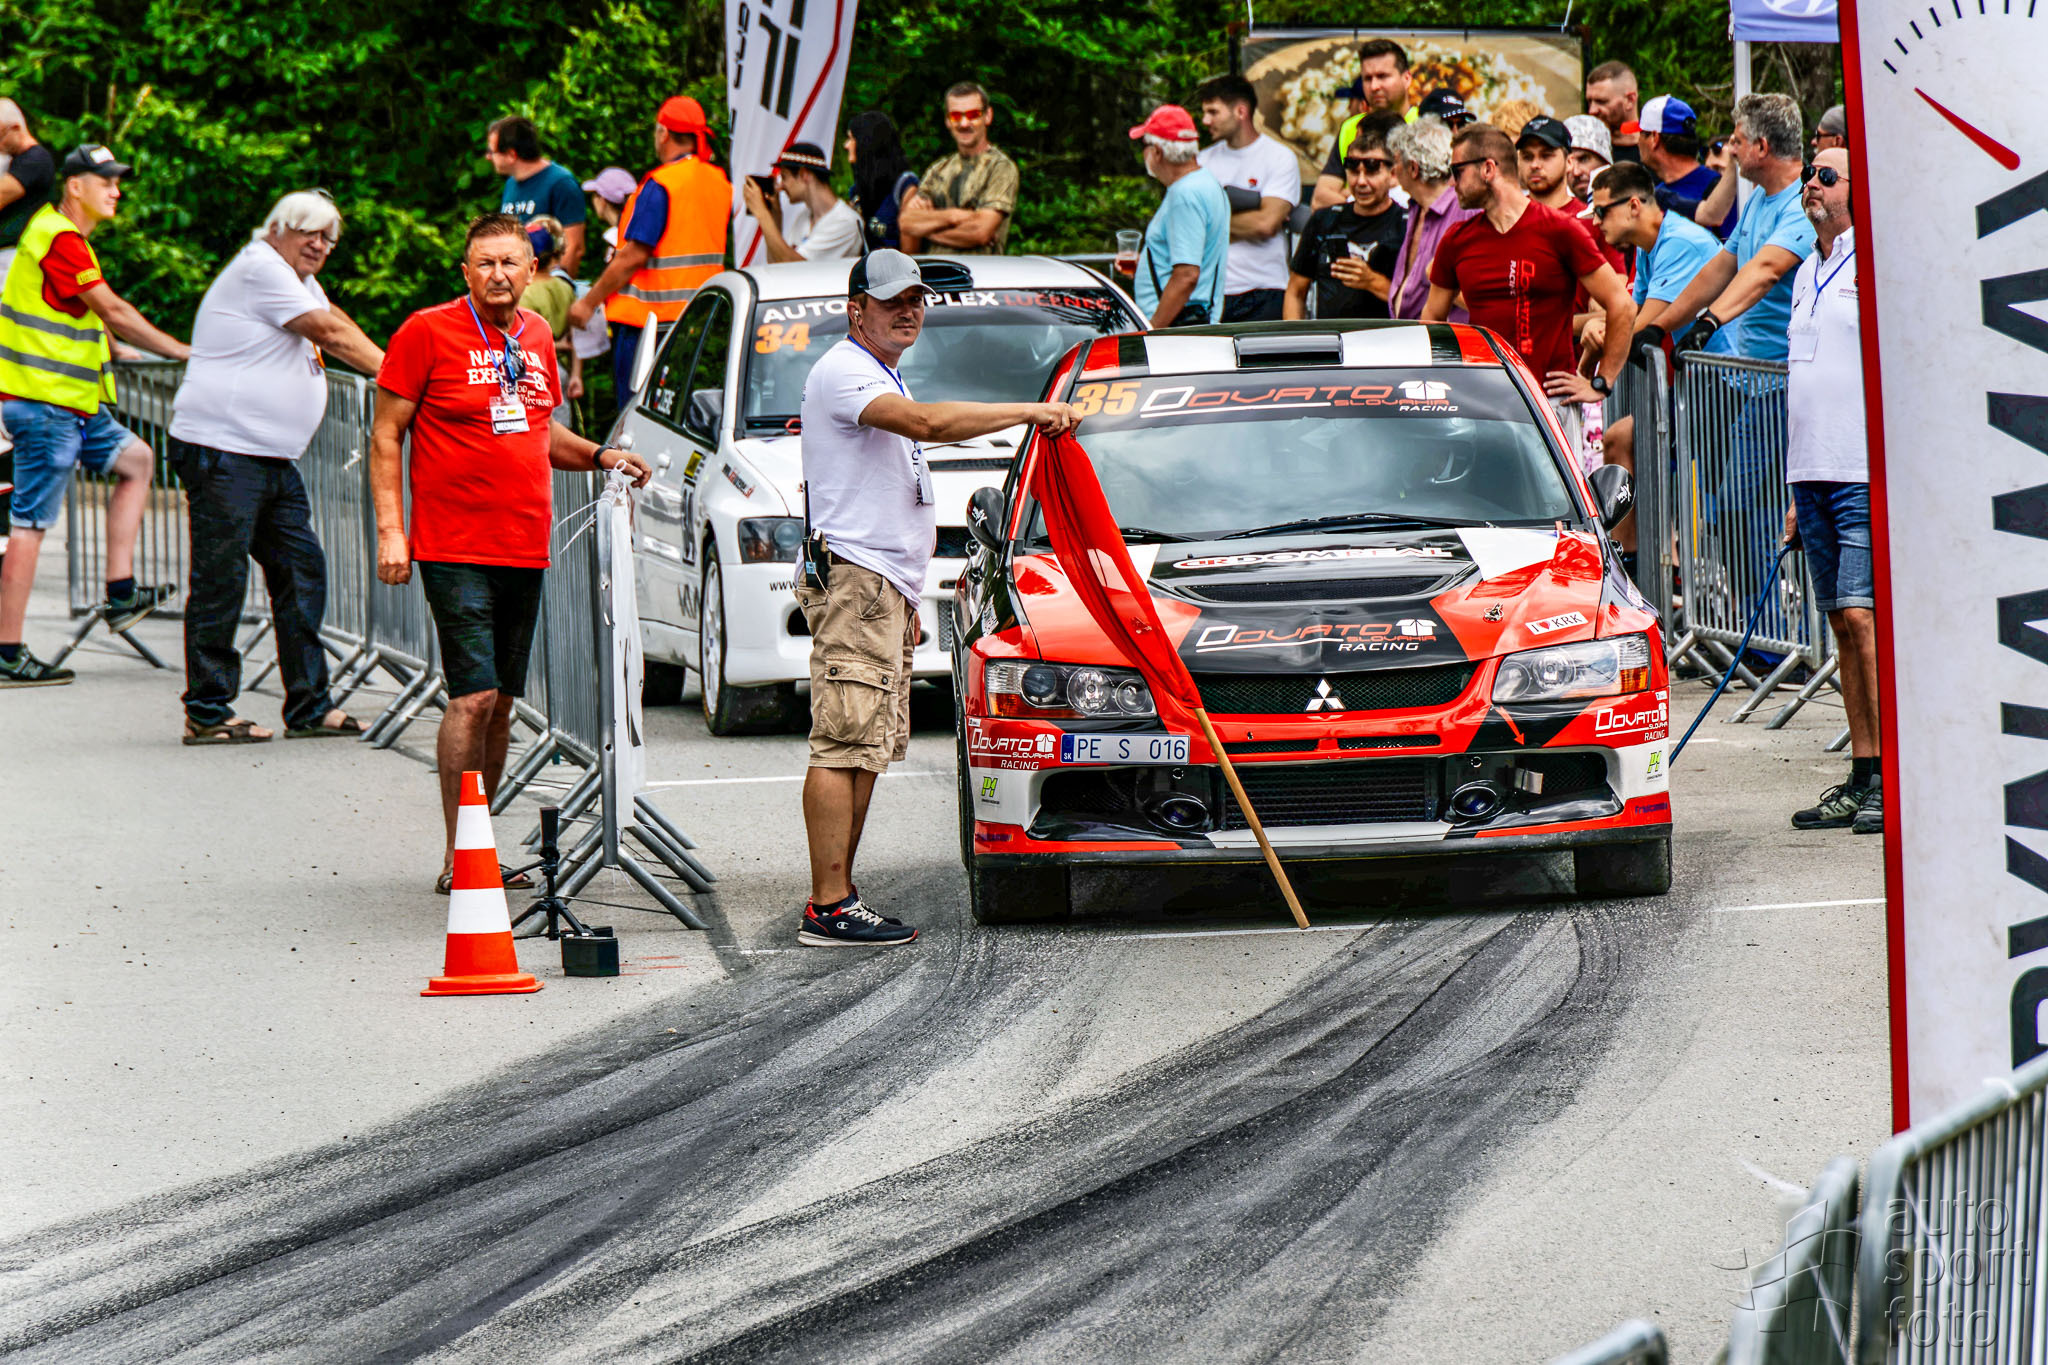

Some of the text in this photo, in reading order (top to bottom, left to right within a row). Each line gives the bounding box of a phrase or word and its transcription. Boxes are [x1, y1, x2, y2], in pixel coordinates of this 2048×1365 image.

[755, 322, 811, 354] 34
[1073, 382, 1142, 416] 35
[1551, 614, 1583, 628] KRK
[1338, 642, 1420, 652] RACING
[1644, 729, 1665, 741] RACING
[1063, 738, 1186, 760] SK PE S 016
[1000, 759, 1040, 770] RACING
